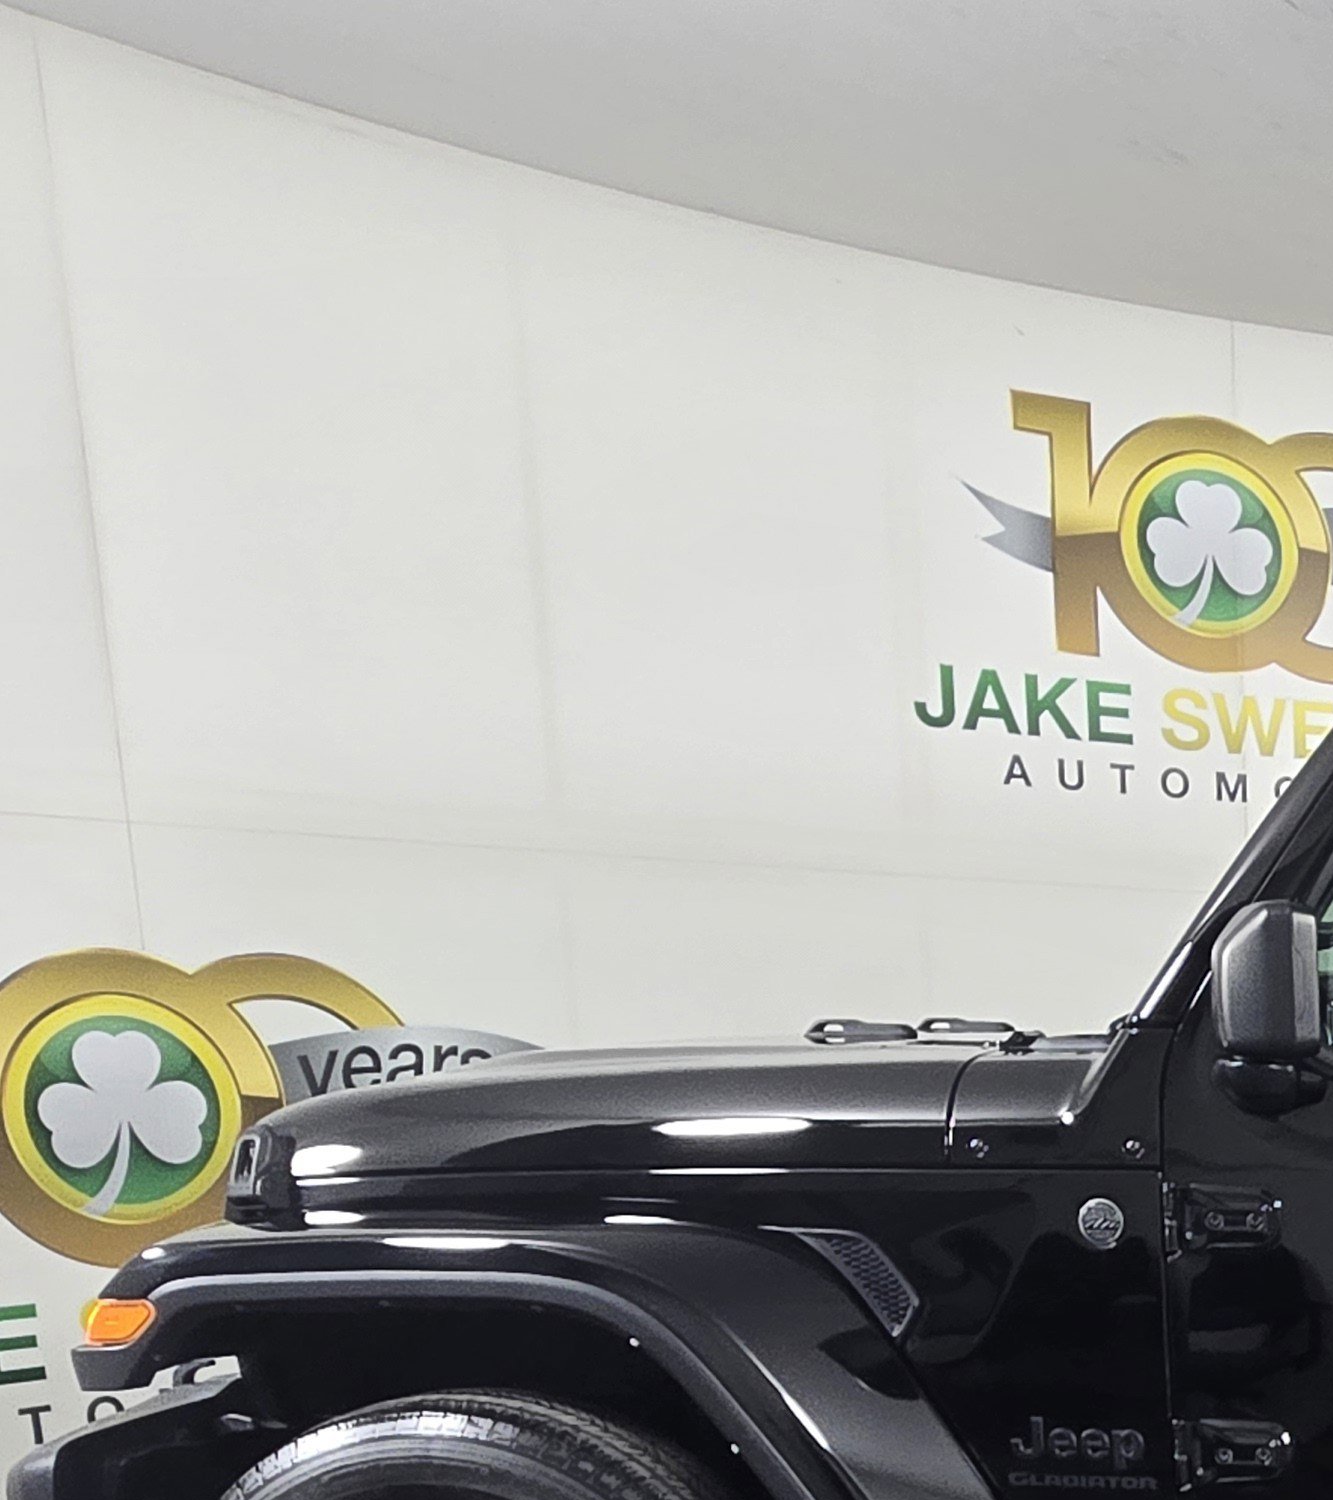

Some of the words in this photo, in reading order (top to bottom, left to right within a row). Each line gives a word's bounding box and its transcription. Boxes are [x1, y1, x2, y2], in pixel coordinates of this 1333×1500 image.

[913, 662, 1135, 747] JAKE
[1010, 1416, 1145, 1470] Jeep
[1008, 1471, 1158, 1491] GLADIATOR
